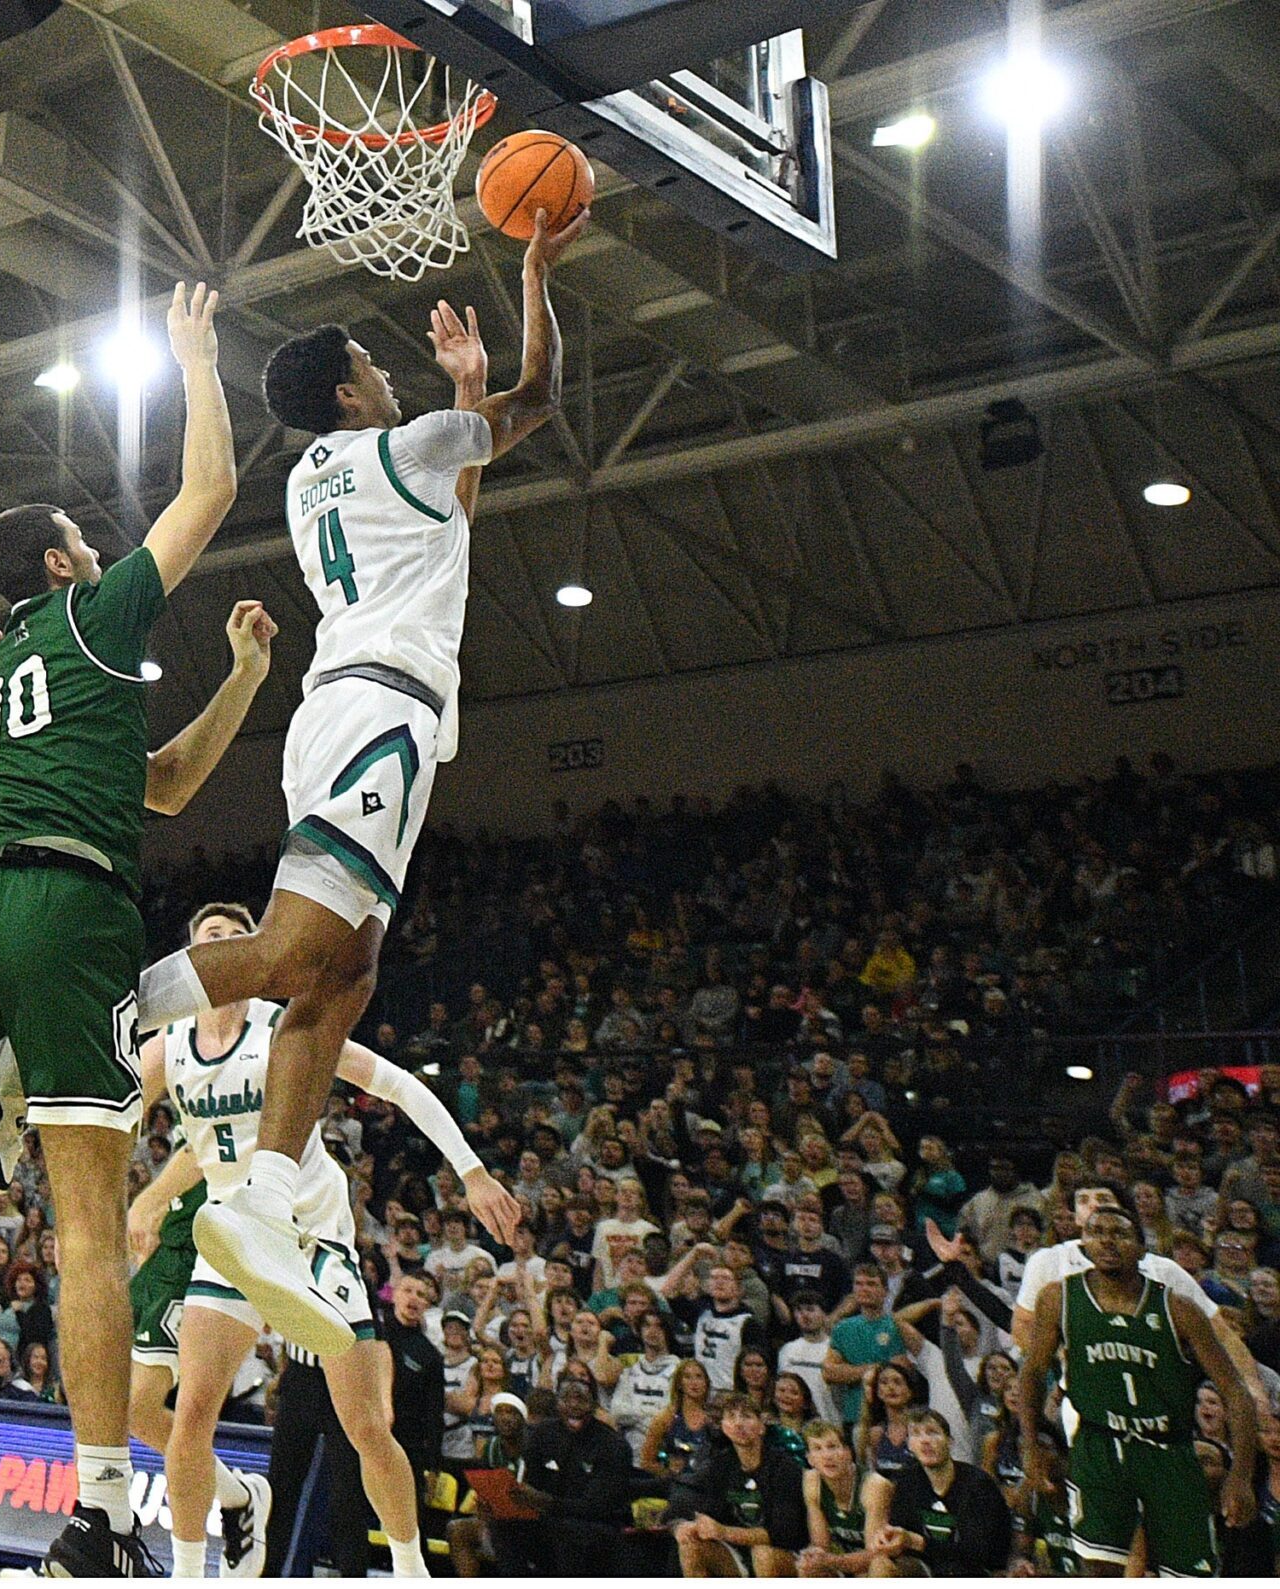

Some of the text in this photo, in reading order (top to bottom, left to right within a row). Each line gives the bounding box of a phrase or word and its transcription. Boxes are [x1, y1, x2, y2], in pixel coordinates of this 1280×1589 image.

[300, 468, 356, 517] HODGE
[317, 506, 360, 606] 4
[1032, 622, 1249, 671] NORTH SIDE
[1108, 669, 1180, 701] 204
[213, 1122, 237, 1163] 5
[1085, 1341, 1158, 1369] MOUNT
[1122, 1372, 1138, 1406] 1
